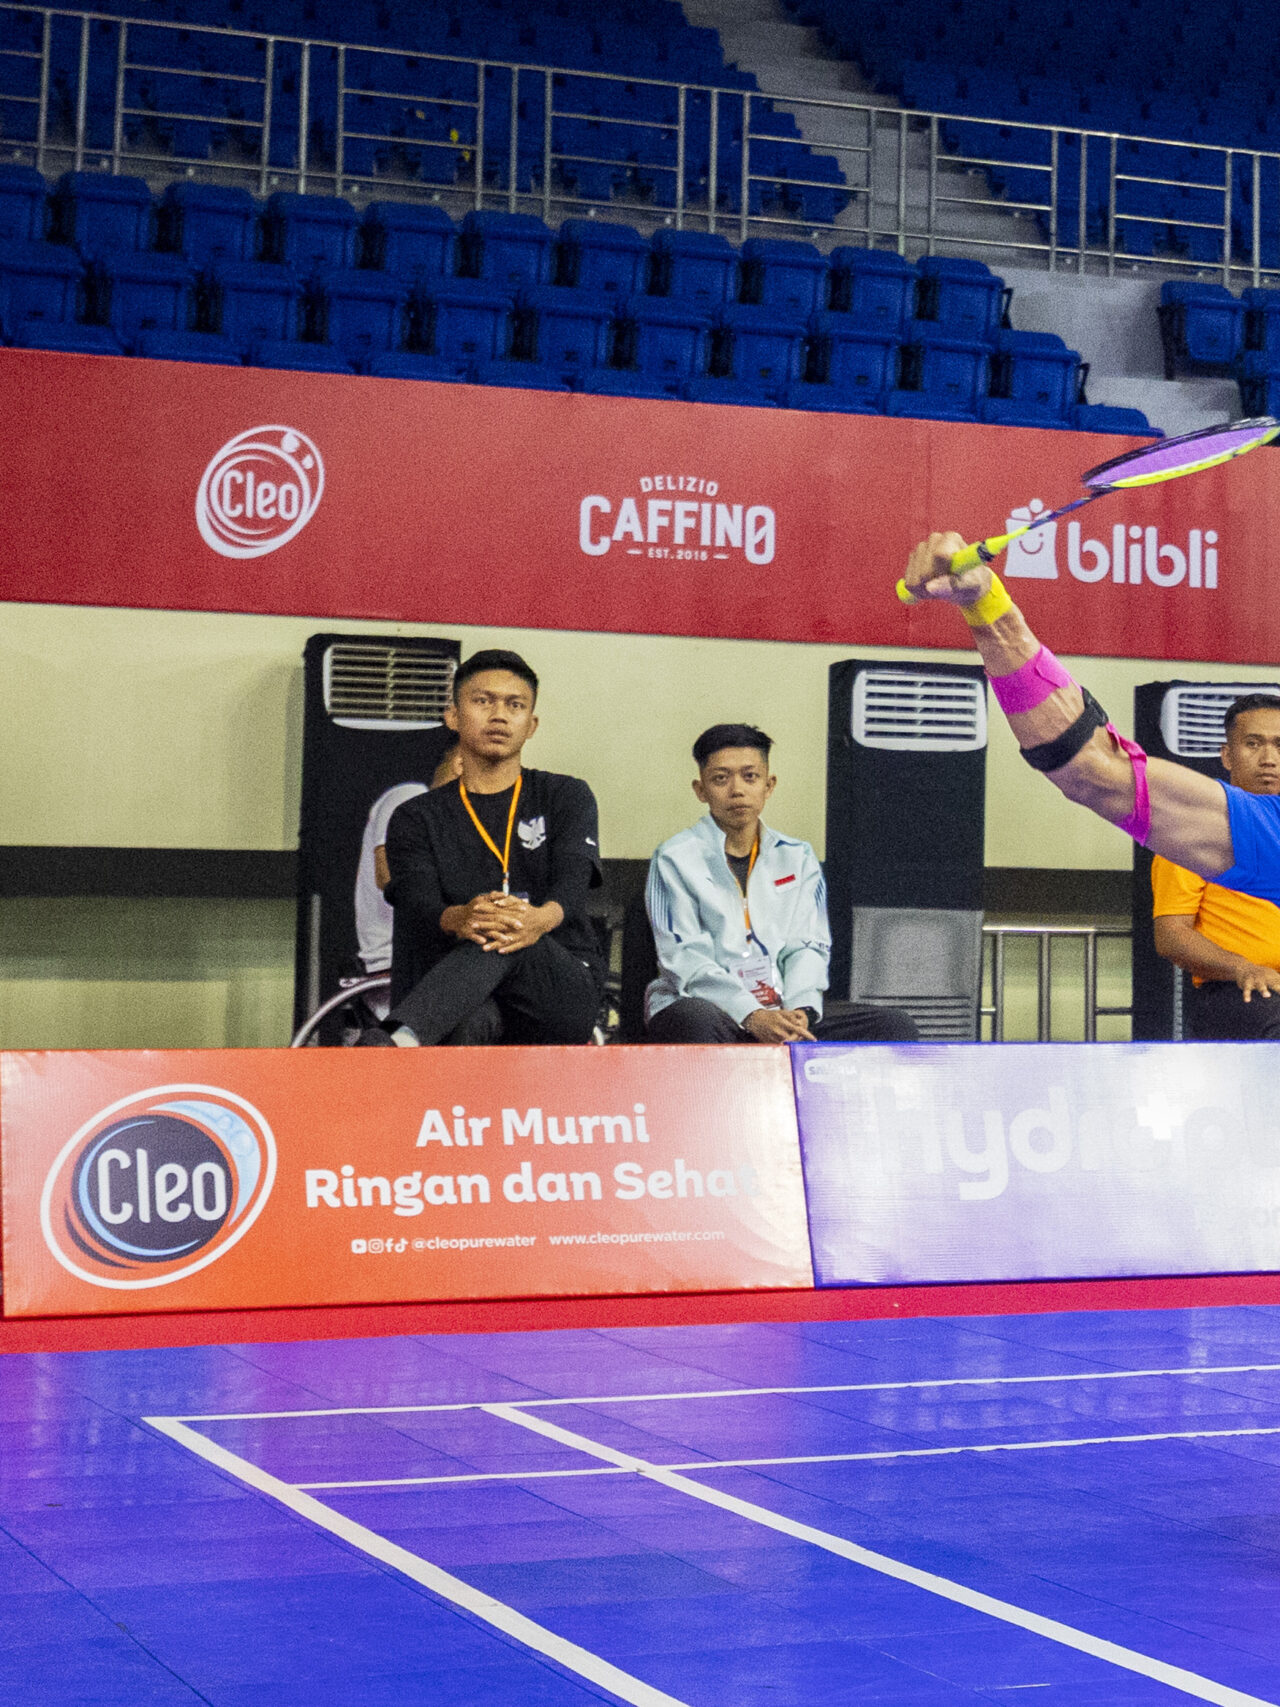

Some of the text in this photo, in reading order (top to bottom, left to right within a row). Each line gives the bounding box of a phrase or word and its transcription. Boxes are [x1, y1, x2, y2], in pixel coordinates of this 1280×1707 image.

[222, 469, 299, 520] Cleo
[639, 475, 719, 497] DELIZIO
[579, 494, 776, 565] CAFFINO
[1067, 520, 1218, 589] blibli
[416, 1103, 650, 1147] Air Murni
[97, 1148, 227, 1224] Cleo
[305, 1158, 763, 1217] Ringan dan Sehat
[411, 1230, 725, 1251] @cleopurewater www.cleopurewater.com
